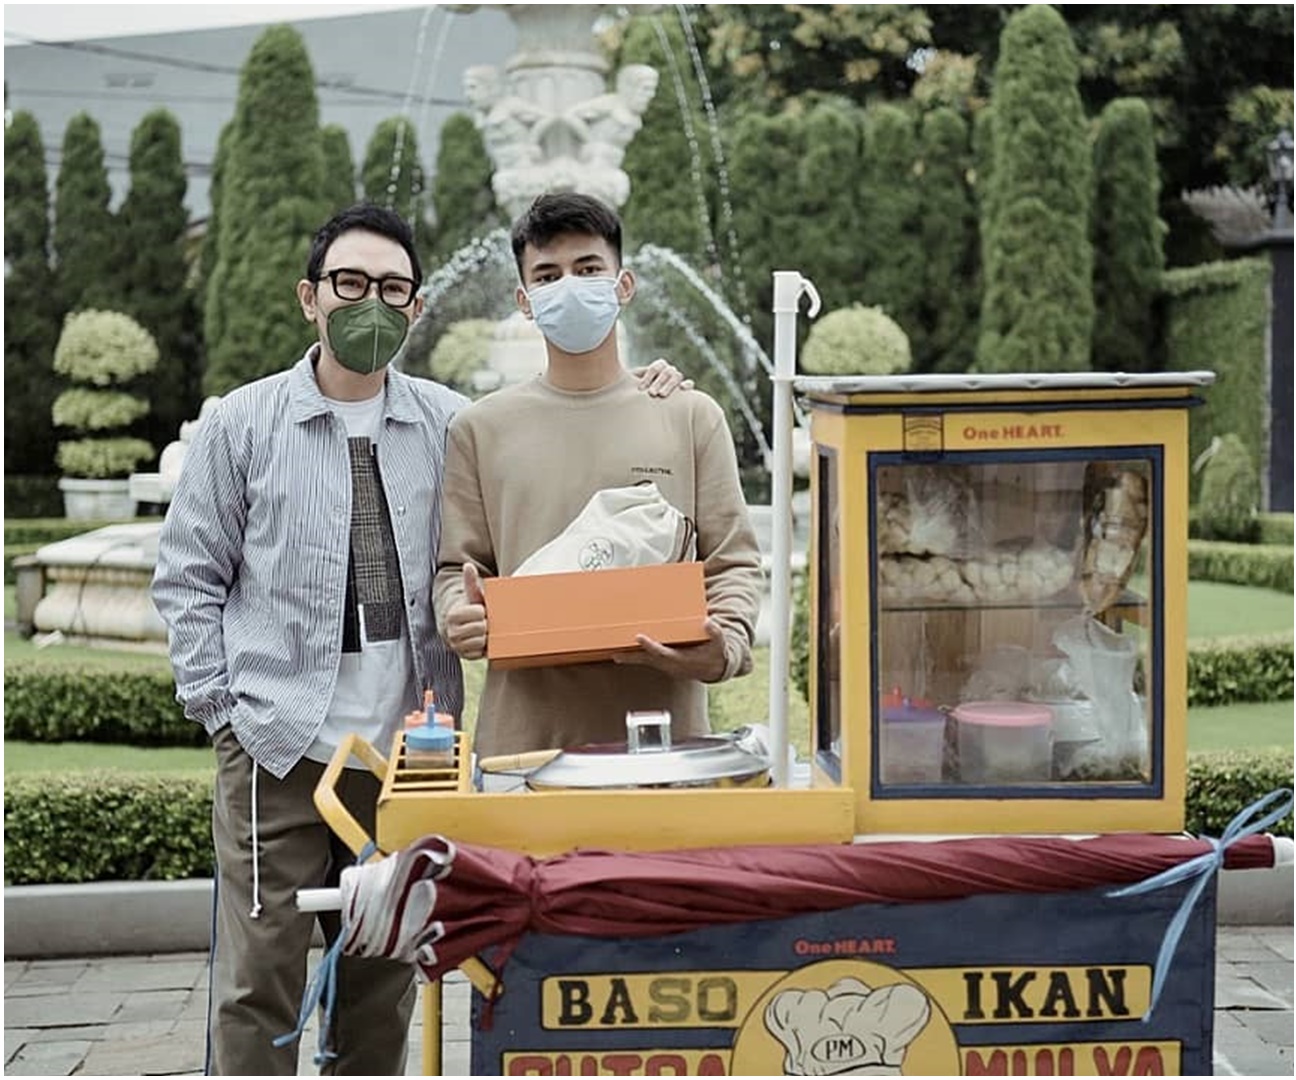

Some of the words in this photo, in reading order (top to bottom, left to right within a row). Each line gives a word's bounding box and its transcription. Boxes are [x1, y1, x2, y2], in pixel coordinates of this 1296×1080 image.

[962, 426, 999, 440] One
[795, 938, 832, 956] One
[558, 976, 738, 1025] BASO
[962, 969, 1130, 1019] IKAN
[826, 1039, 853, 1060] PM
